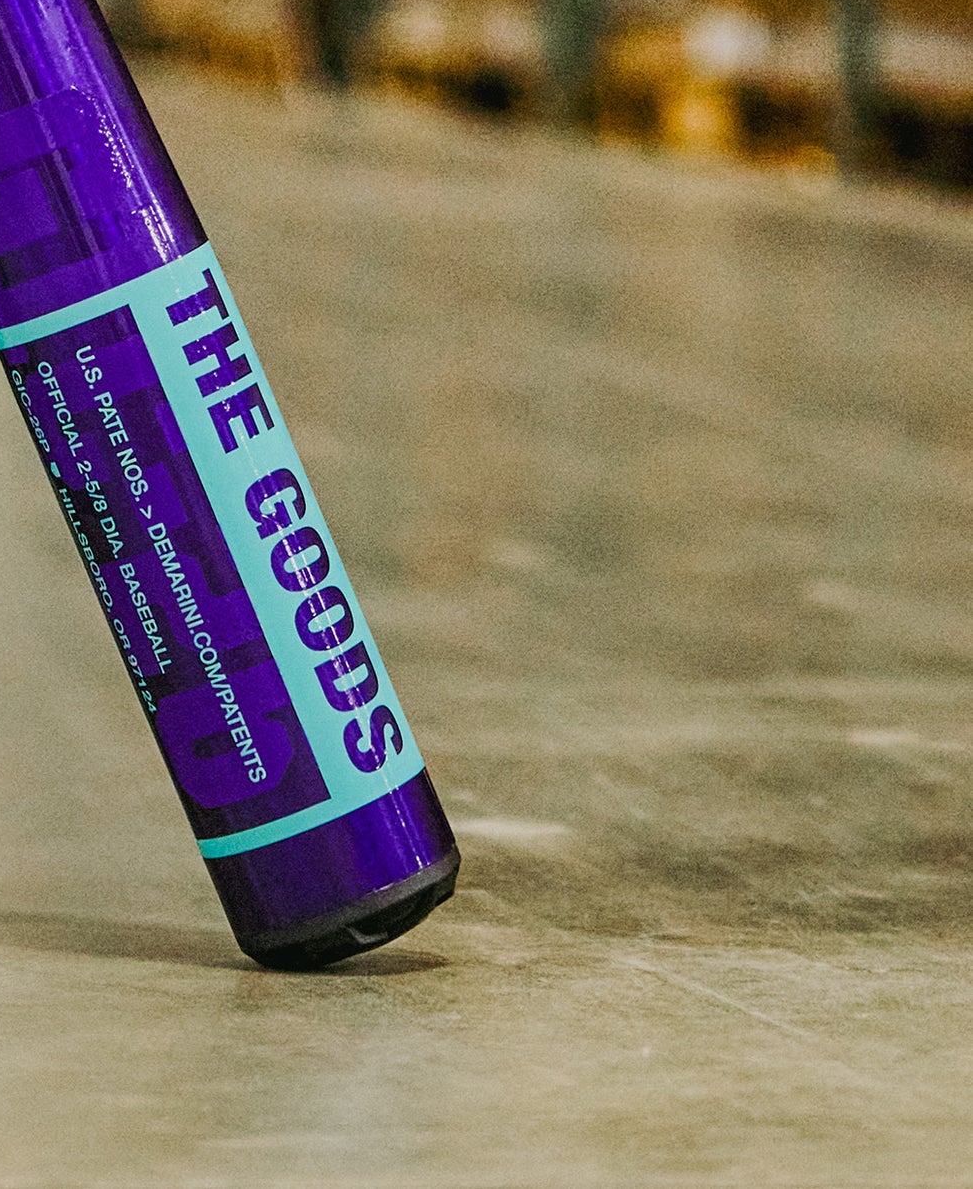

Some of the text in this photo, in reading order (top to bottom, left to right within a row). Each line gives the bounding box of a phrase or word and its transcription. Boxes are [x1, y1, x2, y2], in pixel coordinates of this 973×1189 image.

[37, 361, 171, 674] OFFICIAL 2-5/8 DIA. BASEBALL
[75, 345, 102, 389] U.S.
[93, 391, 128, 446] PATE
[116, 447, 148, 501] NOS.
[147, 522, 266, 782] DEMARINI.COM/PATENTS
[113, 618, 130, 648] OR
[127, 654, 156, 712] 97124
[165, 268, 403, 773] THE GOODS
